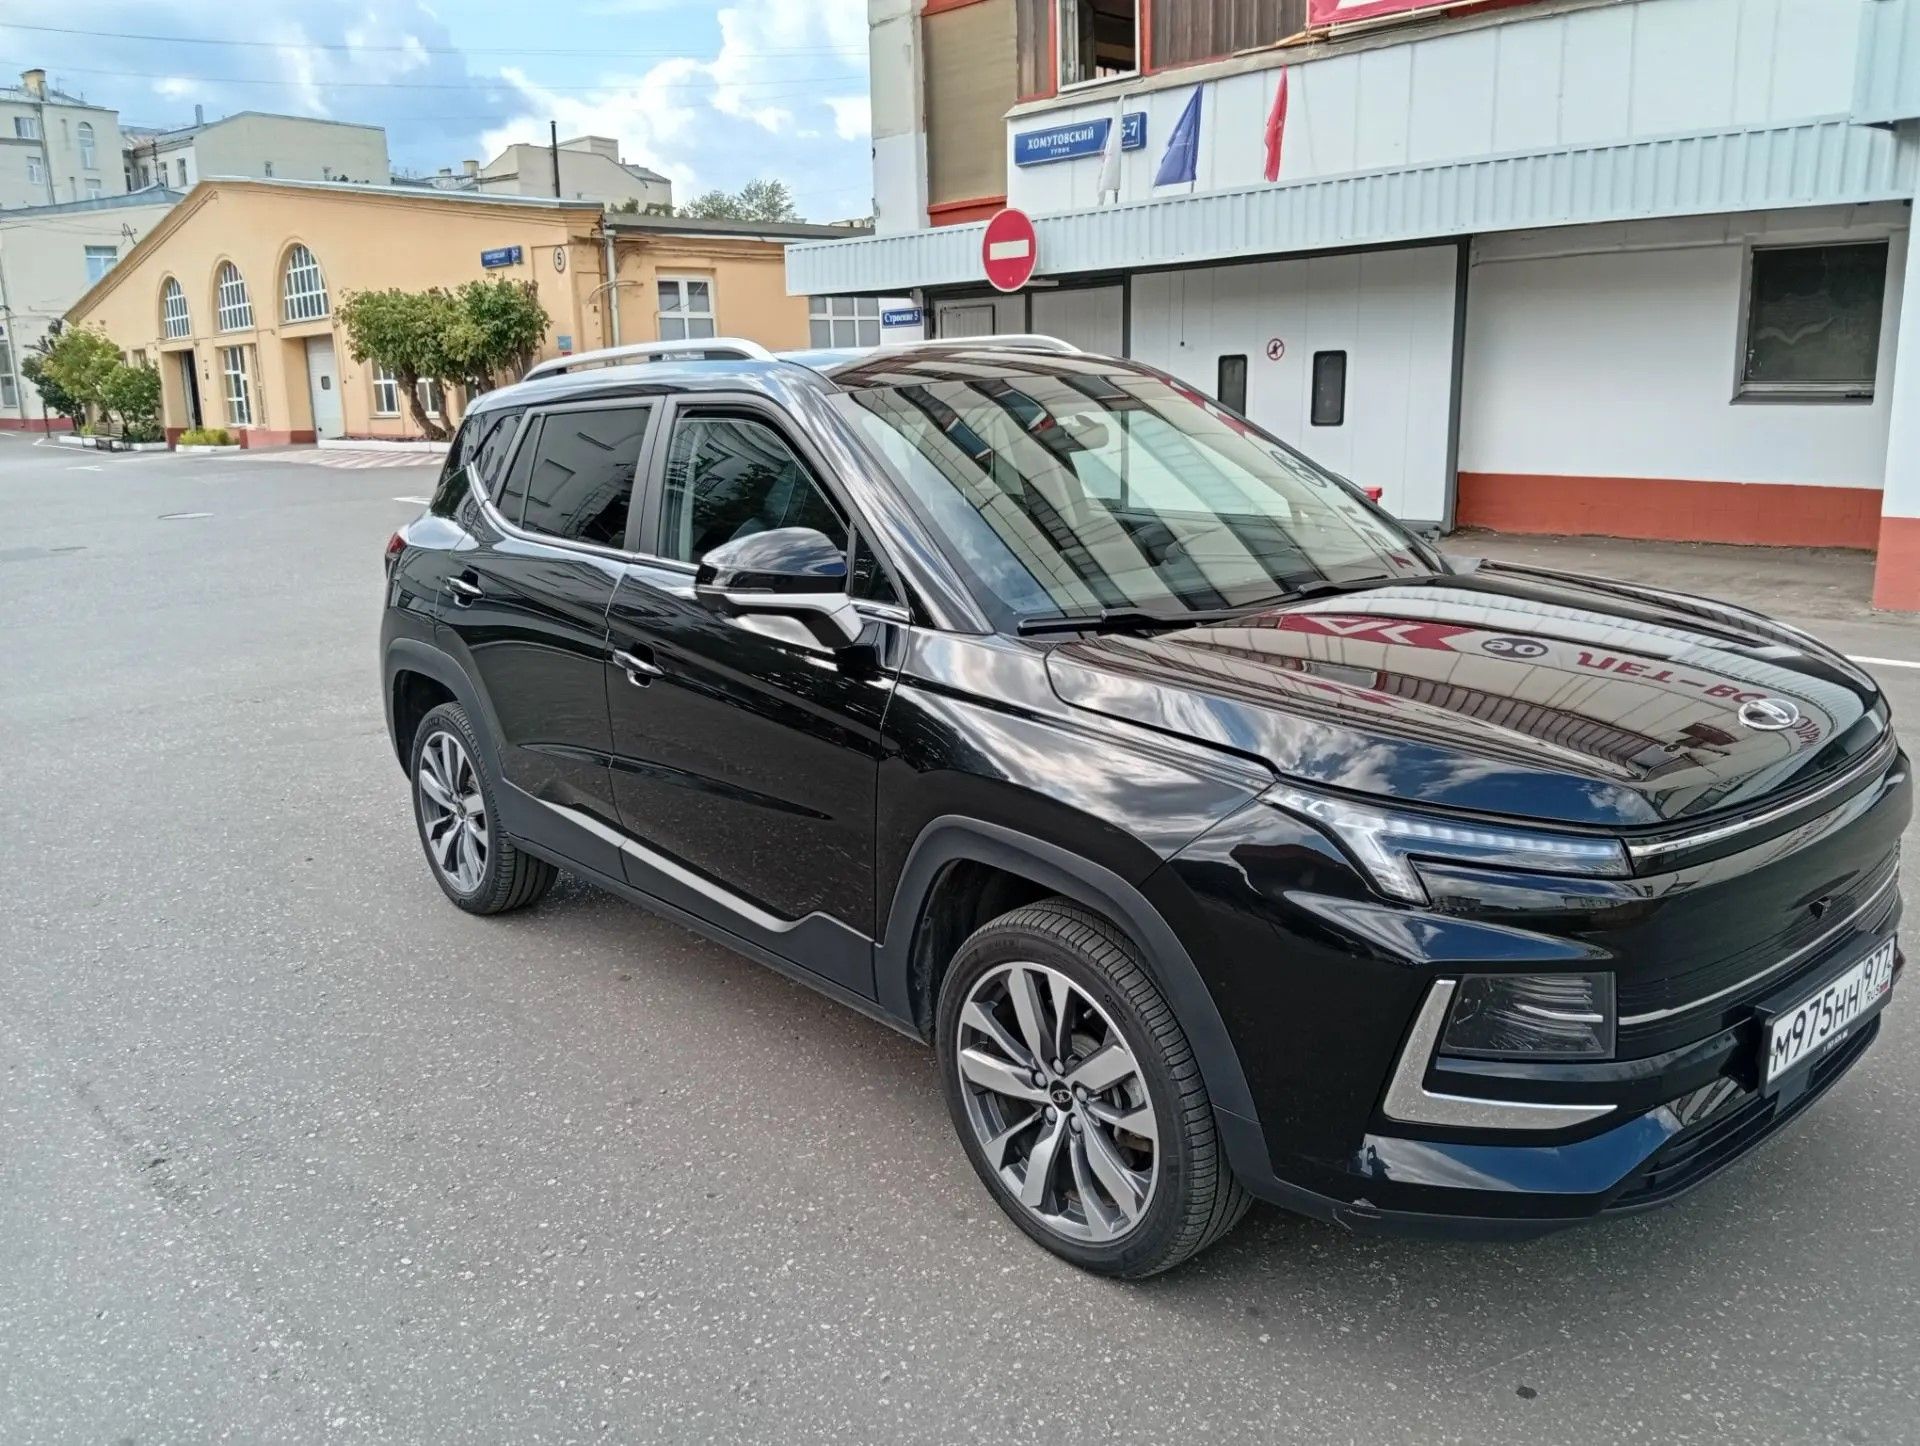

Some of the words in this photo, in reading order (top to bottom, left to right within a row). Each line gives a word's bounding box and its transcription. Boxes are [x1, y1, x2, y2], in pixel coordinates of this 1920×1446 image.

[1027, 126, 1094, 150] ХОМУТОВСКИЙ
[1771, 978, 1861, 1072] М975НН
[1864, 943, 1891, 992] 977
